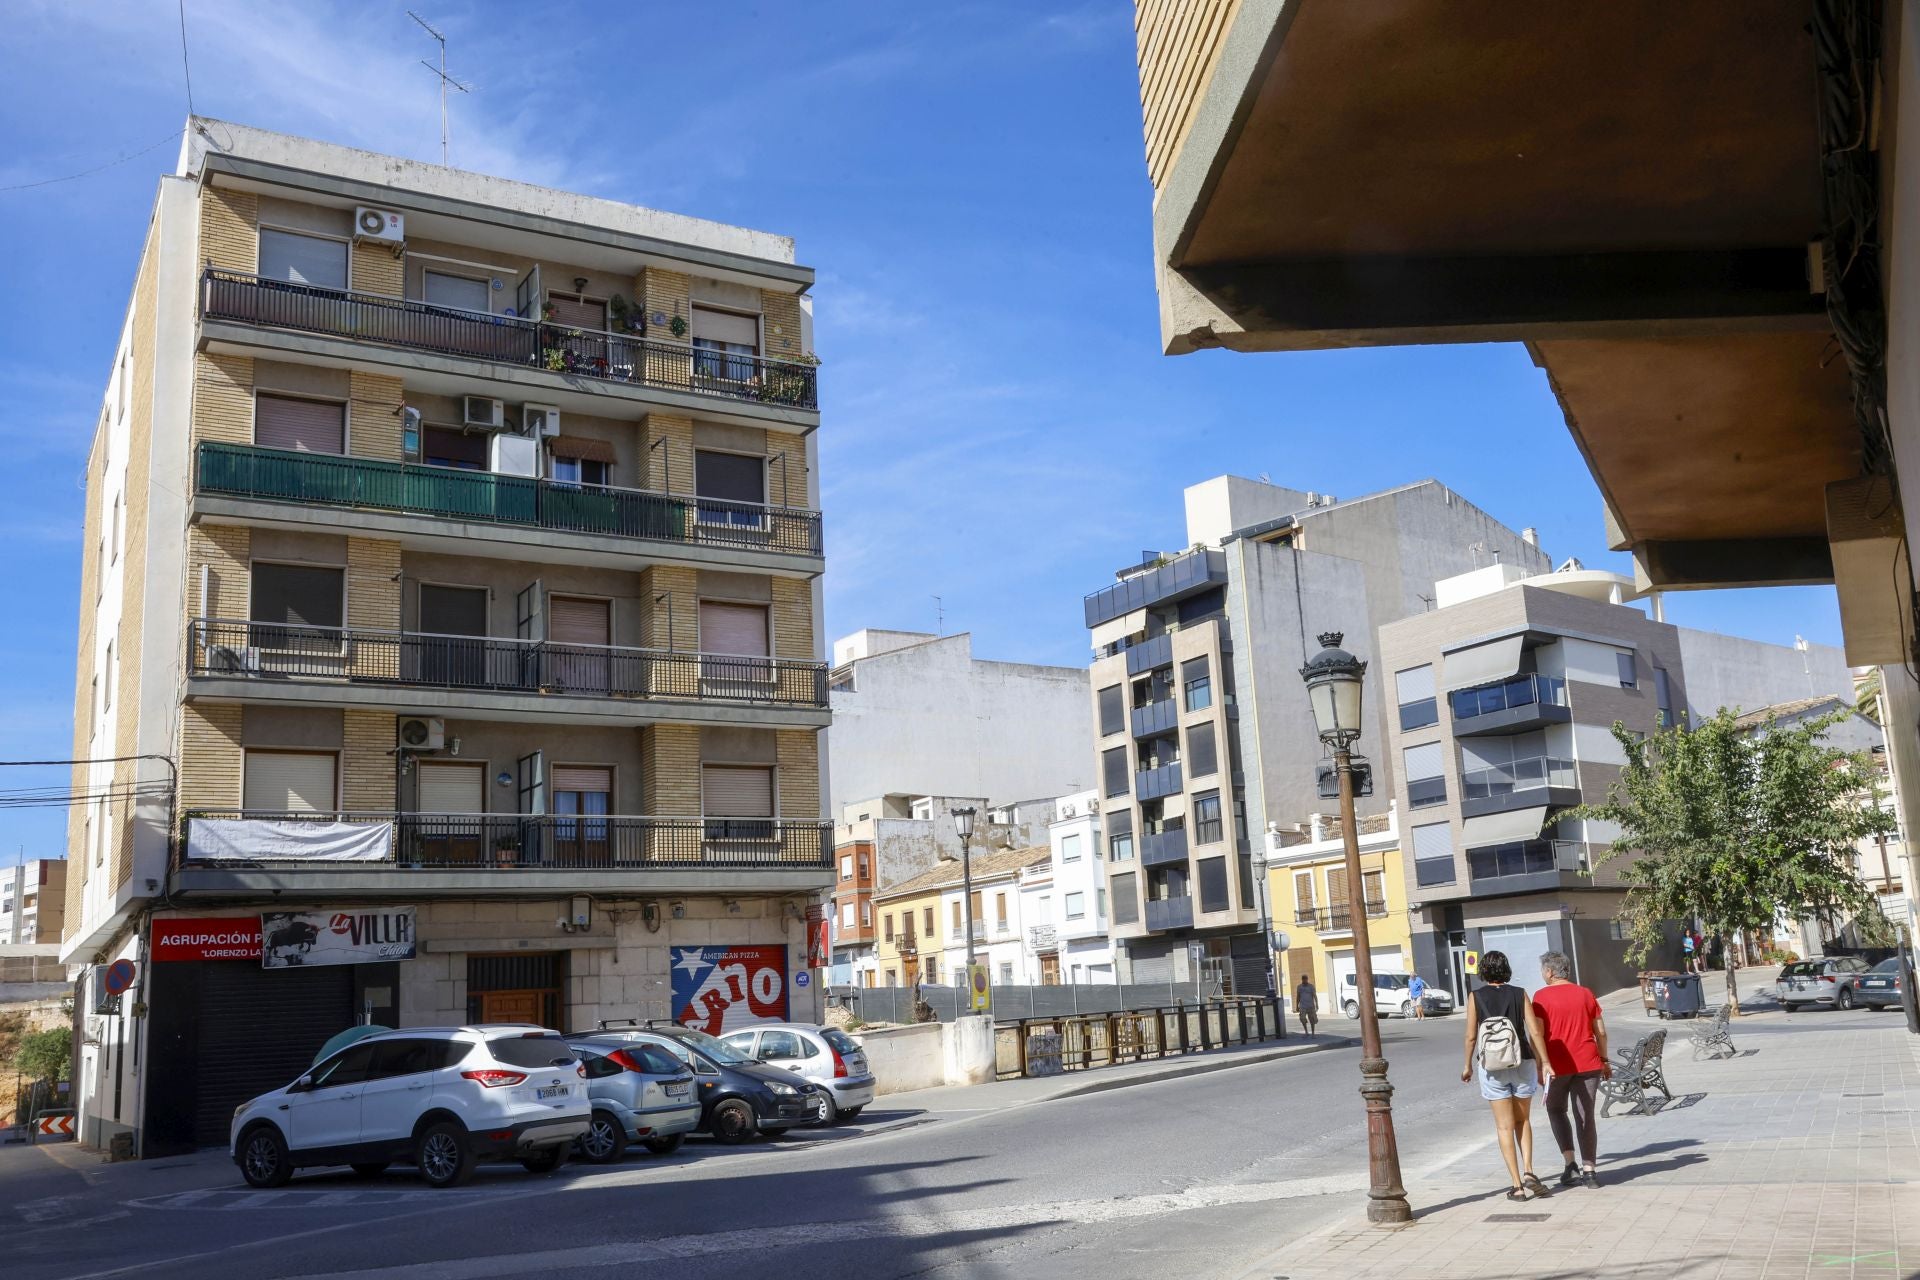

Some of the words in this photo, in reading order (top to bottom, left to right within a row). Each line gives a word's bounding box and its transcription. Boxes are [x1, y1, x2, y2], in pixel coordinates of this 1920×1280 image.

[331, 914, 351, 930] La
[350, 913, 409, 946] VILLA
[160, 931, 250, 945] AGRUPACIÓN
[702, 952, 739, 960] AMERICAN
[740, 951, 760, 959] PIZZA
